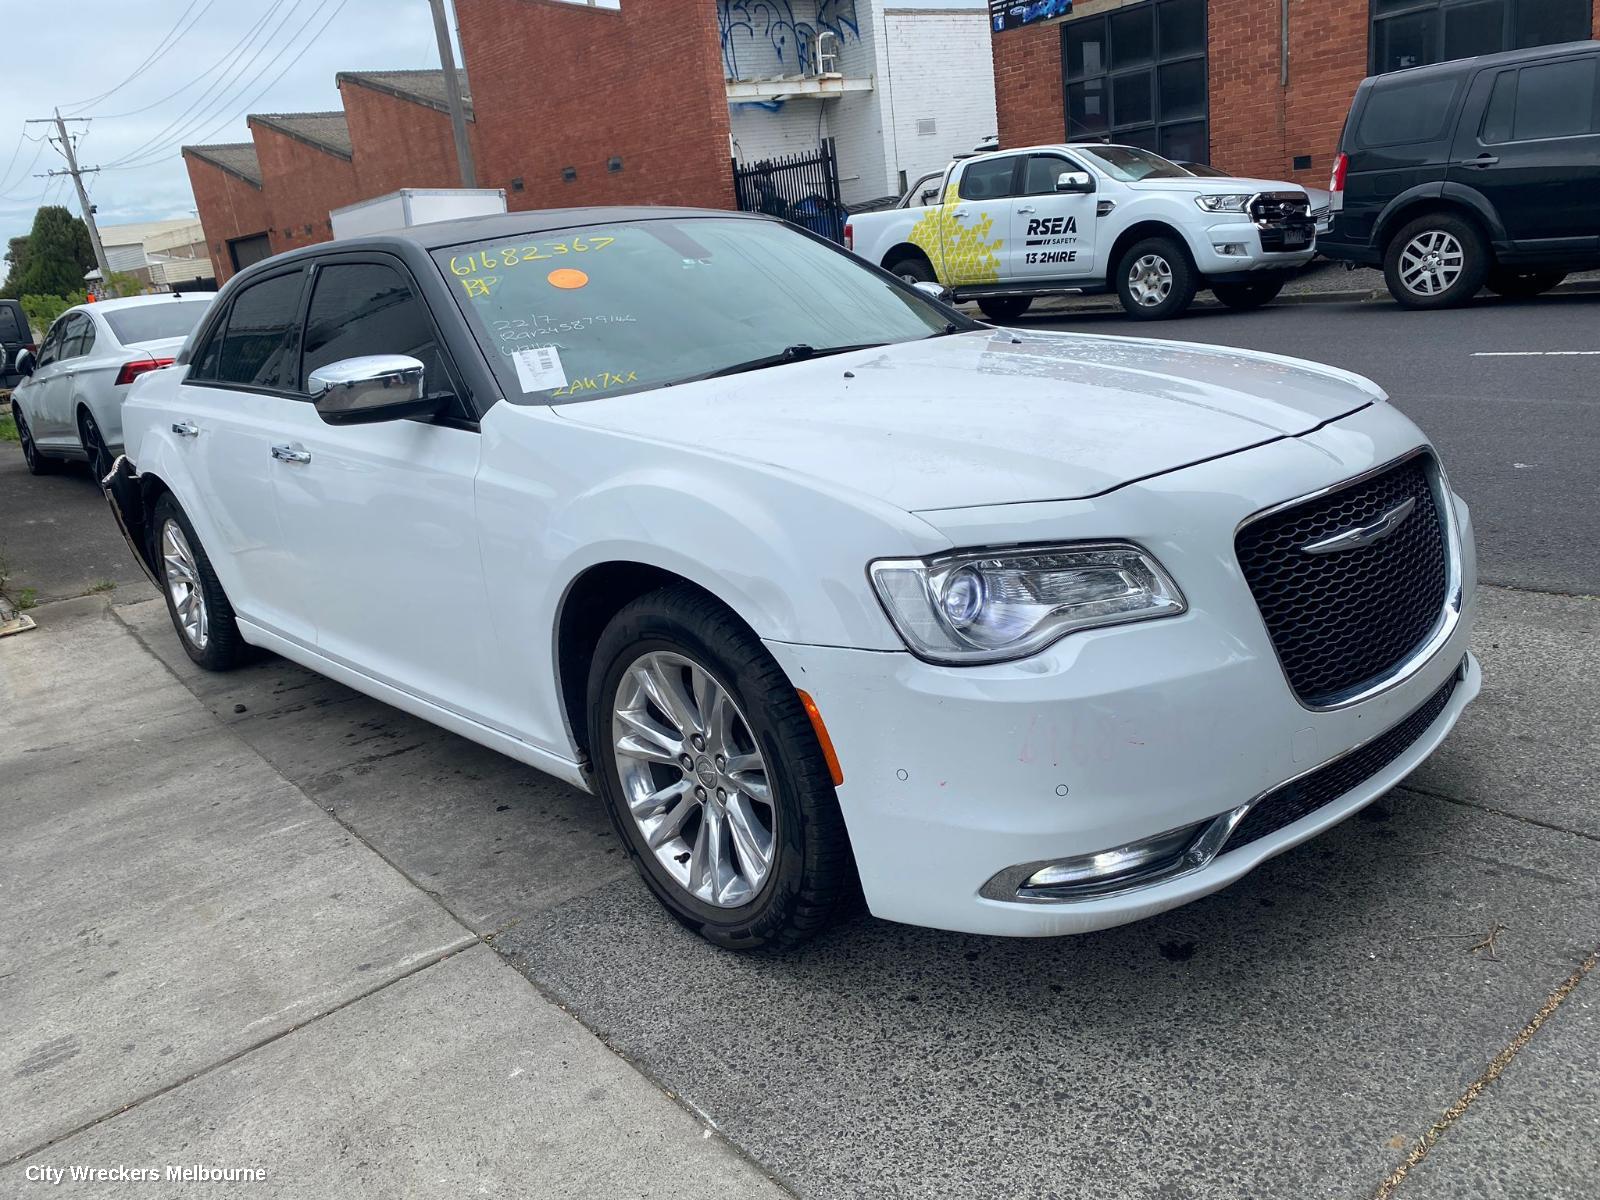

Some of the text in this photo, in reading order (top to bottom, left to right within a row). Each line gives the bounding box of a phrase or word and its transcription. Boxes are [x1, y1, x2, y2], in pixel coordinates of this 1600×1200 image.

[1027, 216, 1077, 235] RSEA
[451, 237, 614, 275] 61682367
[1026, 251, 1077, 264] 13 2HIRE
